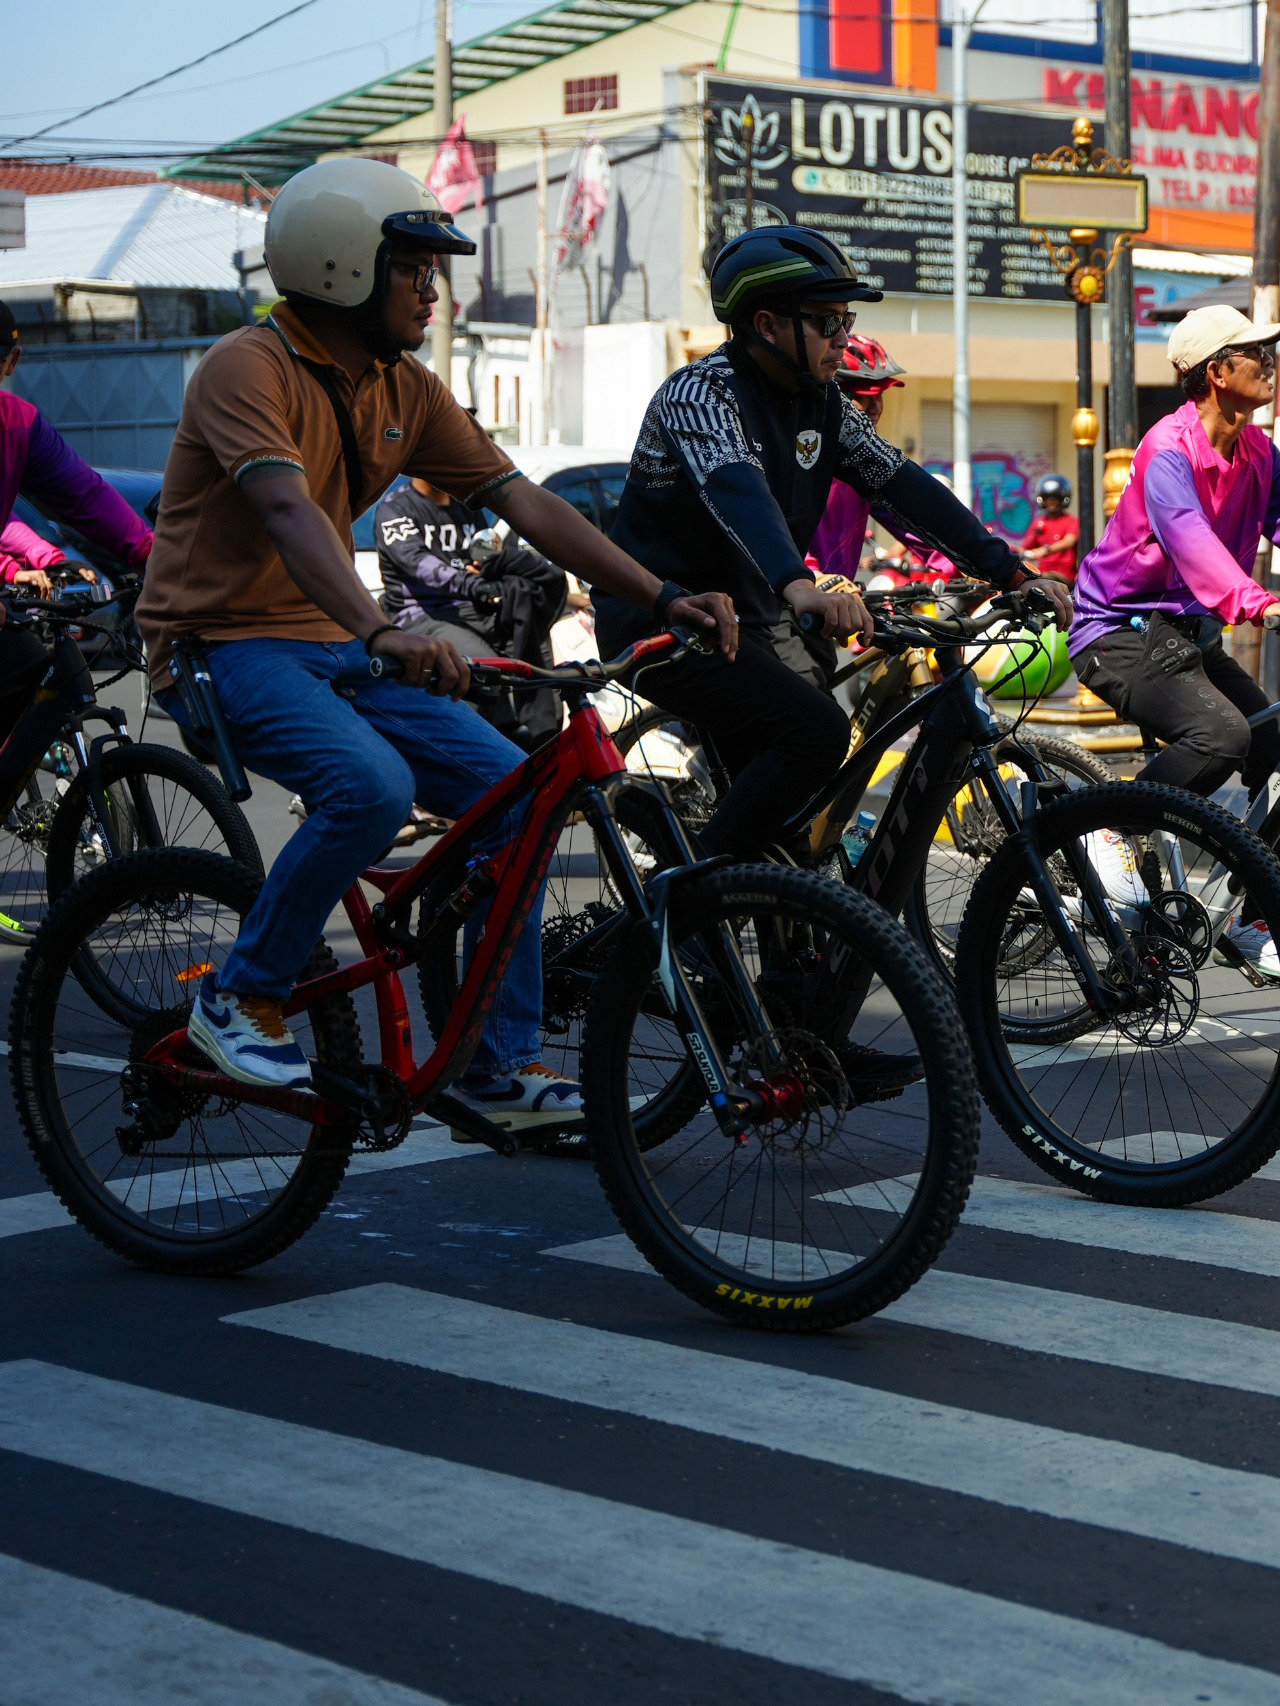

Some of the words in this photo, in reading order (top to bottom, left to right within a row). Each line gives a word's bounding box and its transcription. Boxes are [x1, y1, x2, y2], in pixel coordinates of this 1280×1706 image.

[791, 97, 954, 174] LOTUS
[965, 151, 1008, 178] OUSE
[1021, 1124, 1103, 1180] MAXXIS
[714, 1283, 814, 1310] MAXXIS
